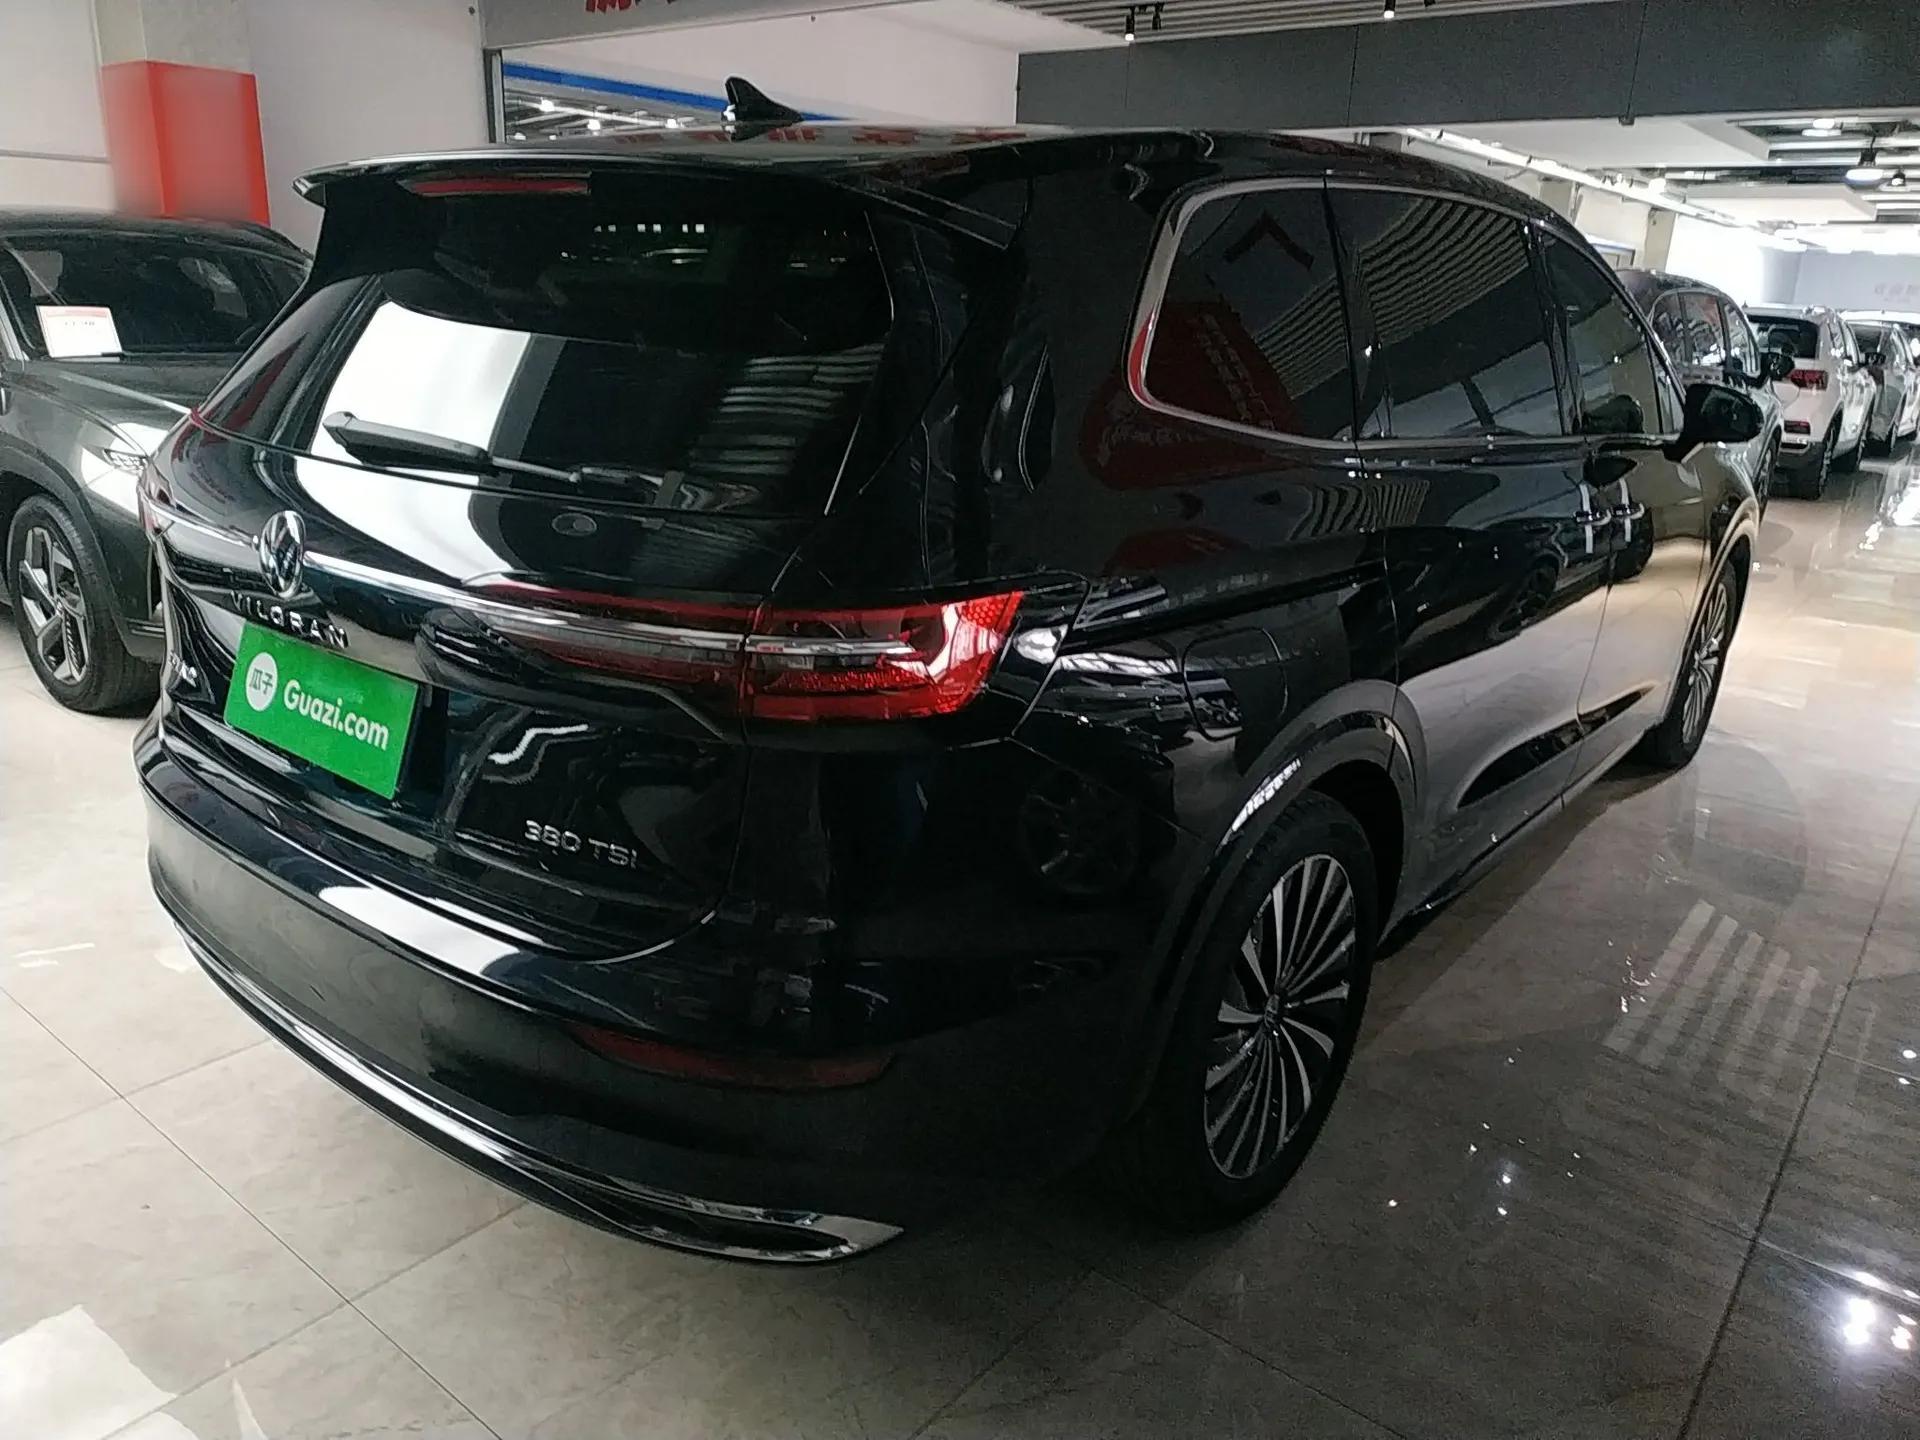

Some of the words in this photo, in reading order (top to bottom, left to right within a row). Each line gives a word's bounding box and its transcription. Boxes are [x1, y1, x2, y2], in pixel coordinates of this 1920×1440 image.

[250, 667, 274, 695] 瓜子
[283, 679, 390, 751] Guazi.com
[524, 819, 582, 852] 380
